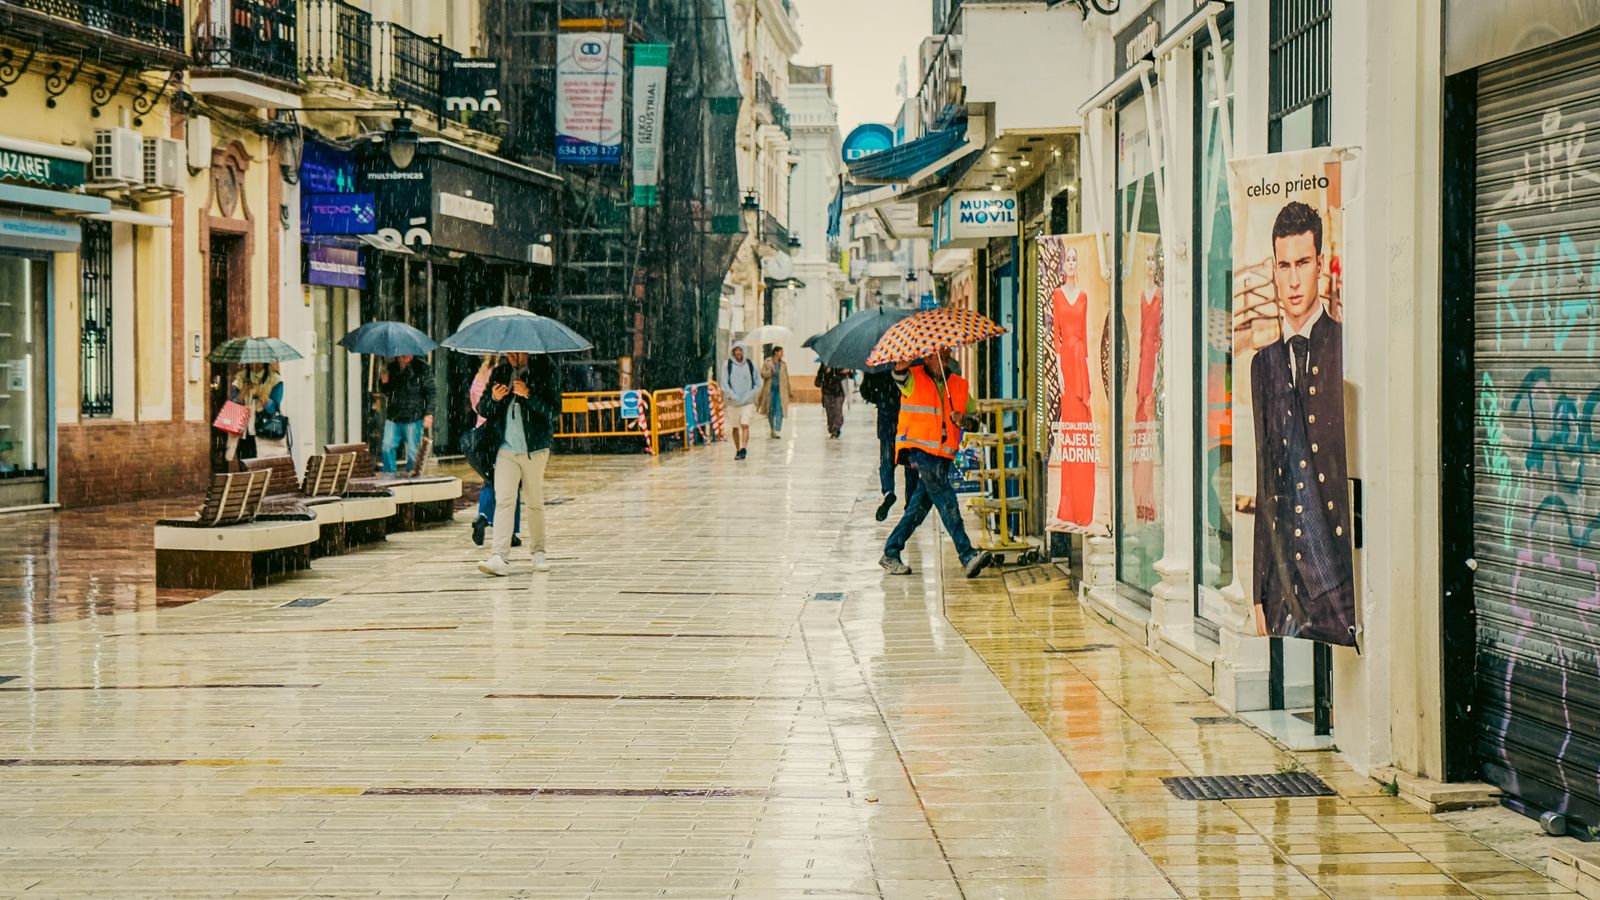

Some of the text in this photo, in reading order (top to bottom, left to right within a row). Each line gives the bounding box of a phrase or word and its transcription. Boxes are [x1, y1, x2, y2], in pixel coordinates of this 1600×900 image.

[646, 83, 656, 144] INDUSTRIAL
[637, 114, 646, 144] GEKO
[1247, 174, 1329, 198] celso prieto
[960, 198, 1015, 210] MUNDO
[960, 210, 1015, 223] MOVIL
[1054, 432, 1101, 447] TRAJES DE
[1052, 447, 1101, 462] MADRINA
